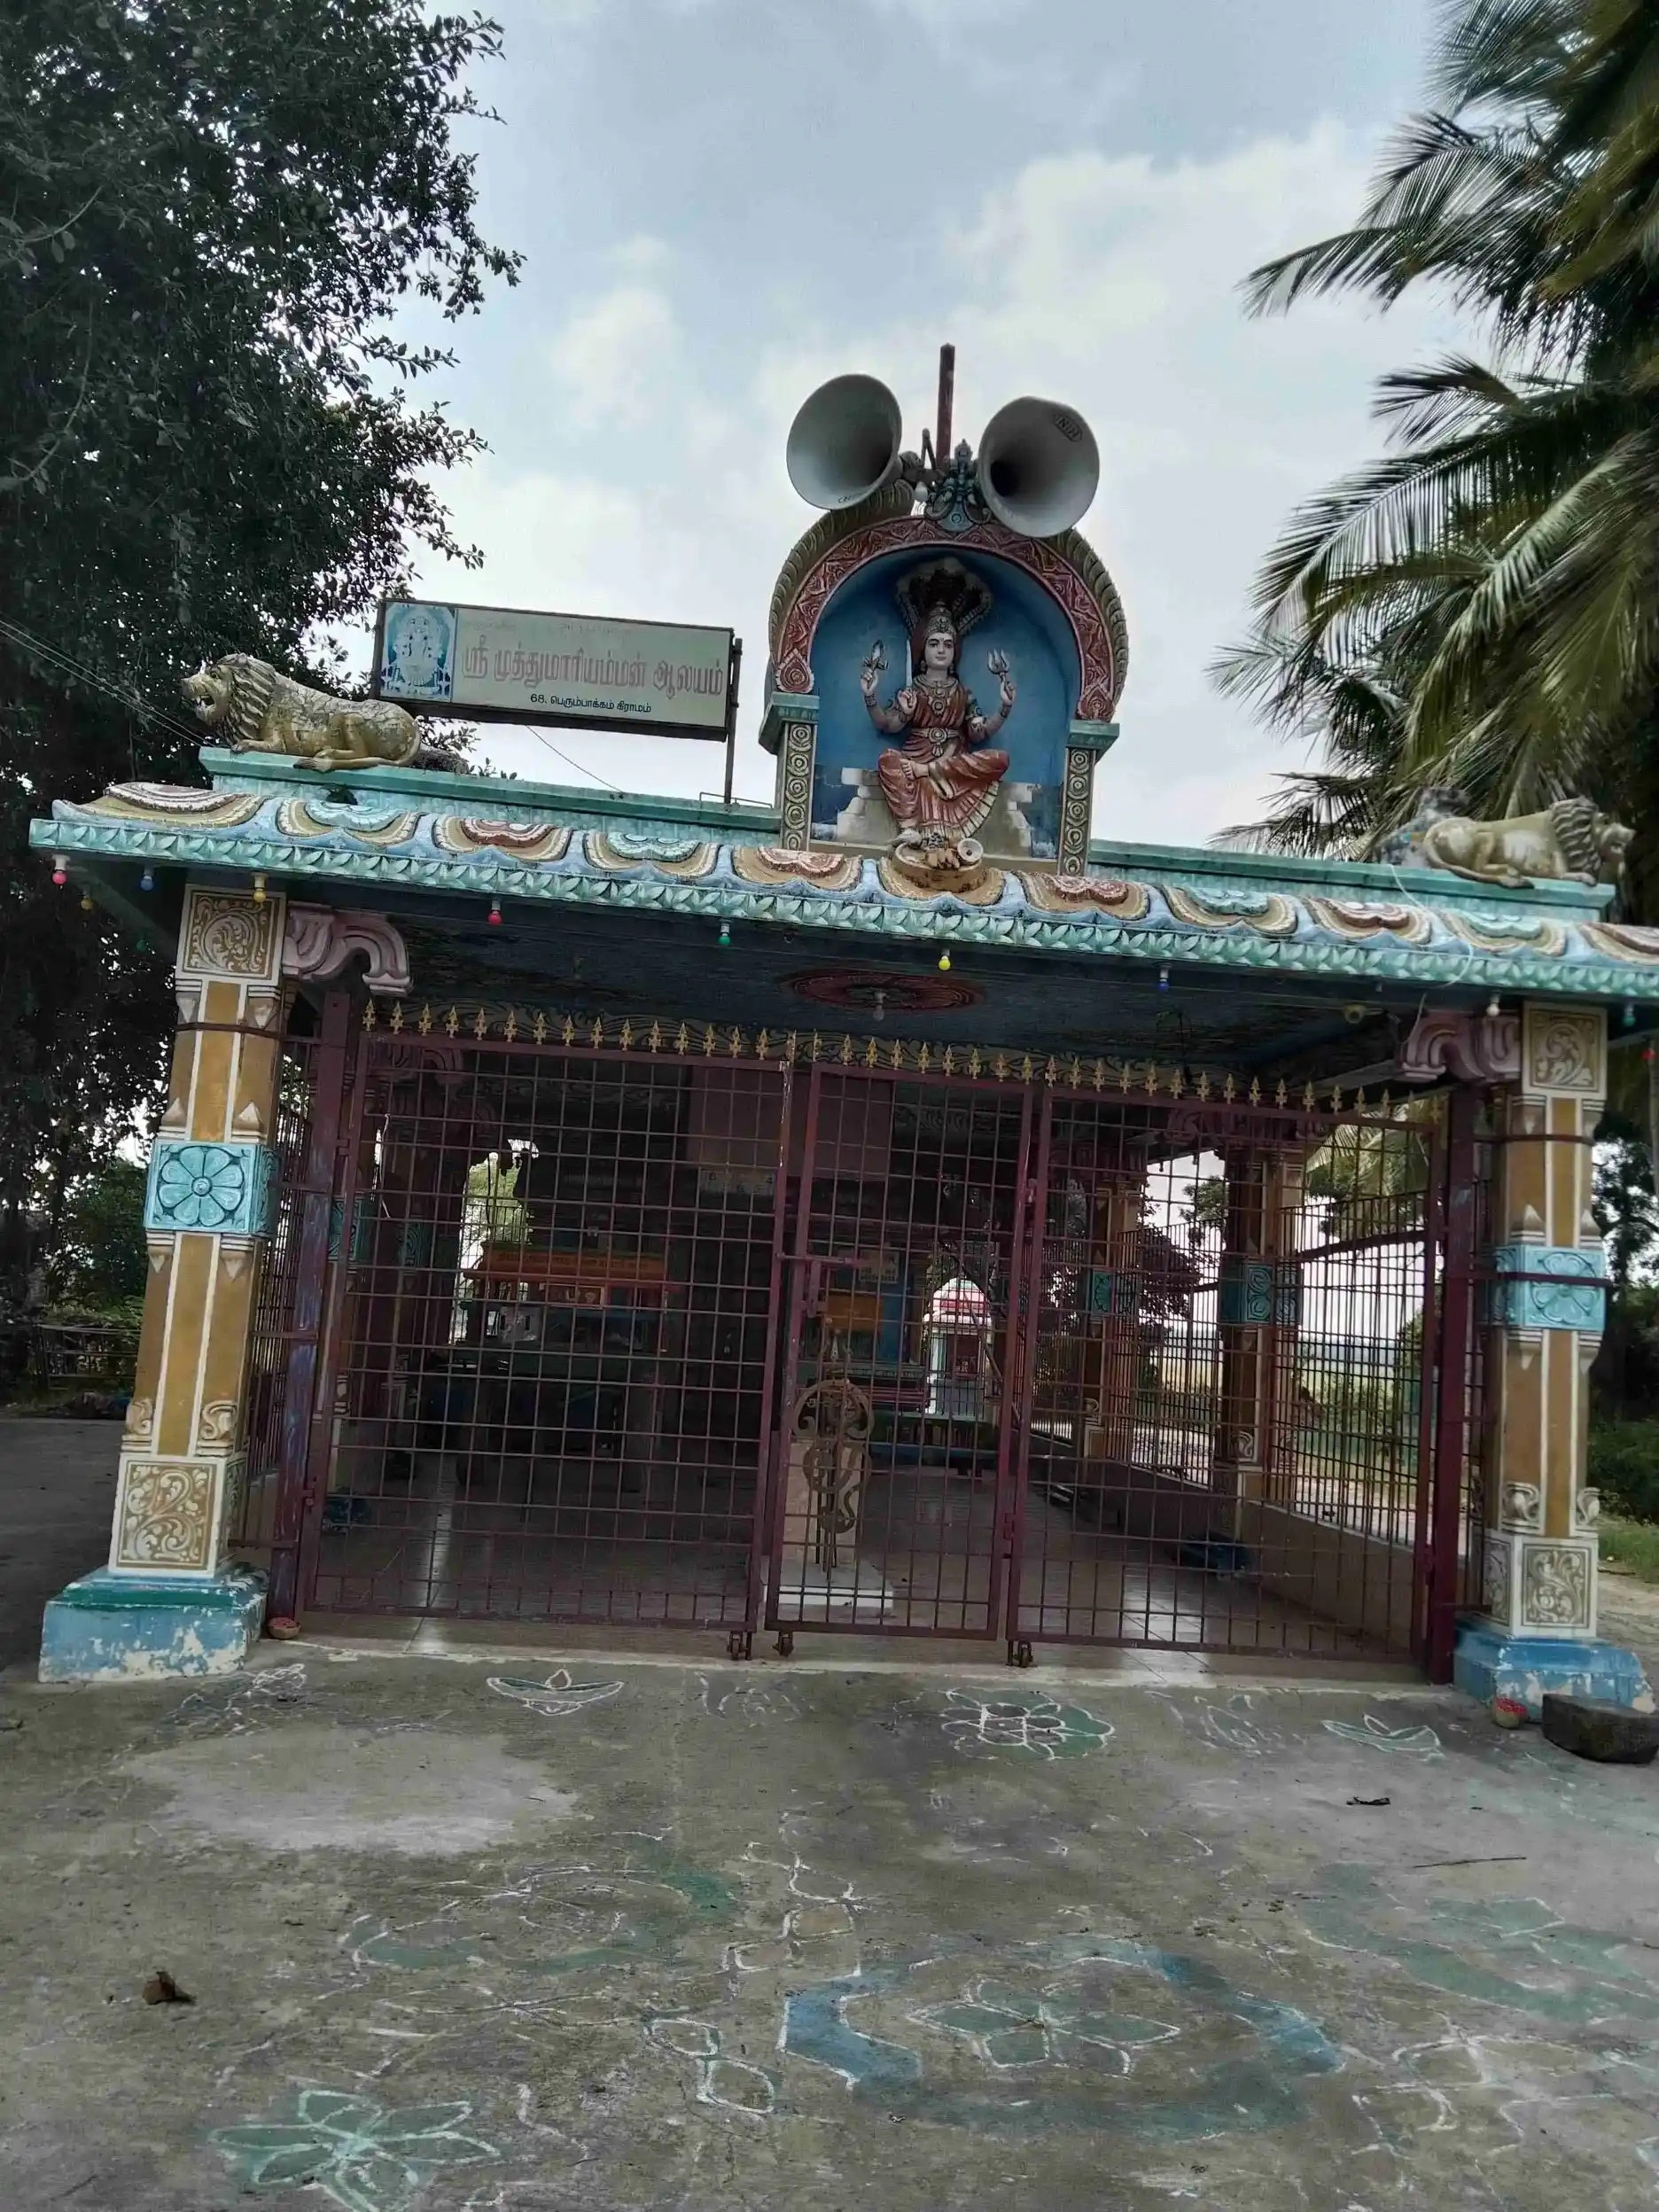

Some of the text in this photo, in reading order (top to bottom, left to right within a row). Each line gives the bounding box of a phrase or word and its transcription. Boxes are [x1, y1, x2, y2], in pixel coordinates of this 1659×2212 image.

[494, 641, 647, 689] முத்துமாரியம்மன்
[652, 658, 723, 700] ஆலயம்
[549, 695, 615, 710] பெரும்பாக்கம்
[616, 699, 652, 713] கிராமம்
